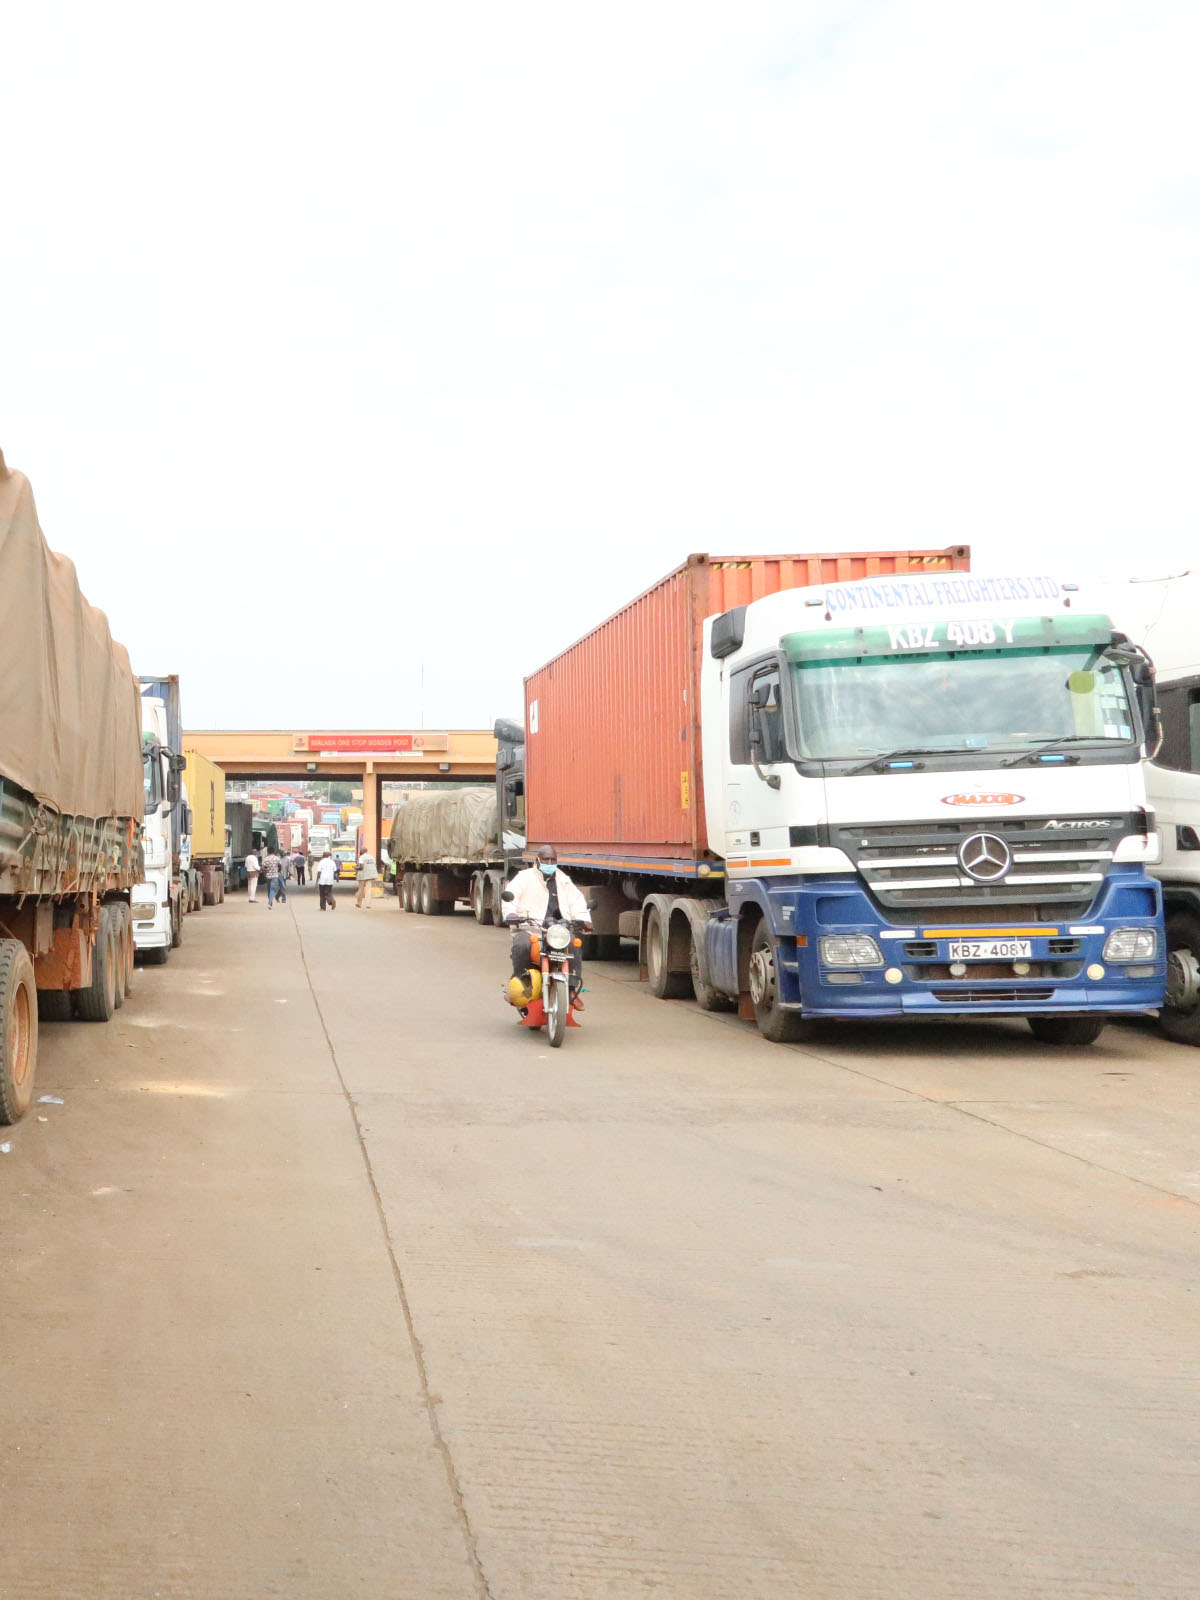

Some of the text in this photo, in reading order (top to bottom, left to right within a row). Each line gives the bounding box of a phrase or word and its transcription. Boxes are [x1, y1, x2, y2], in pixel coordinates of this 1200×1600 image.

[825, 576, 1060, 611] CONTINENTAL FREIGHTERS LTD
[887, 622, 939, 650] KBZ
[951, 943, 1028, 958] KBZ 408Y
